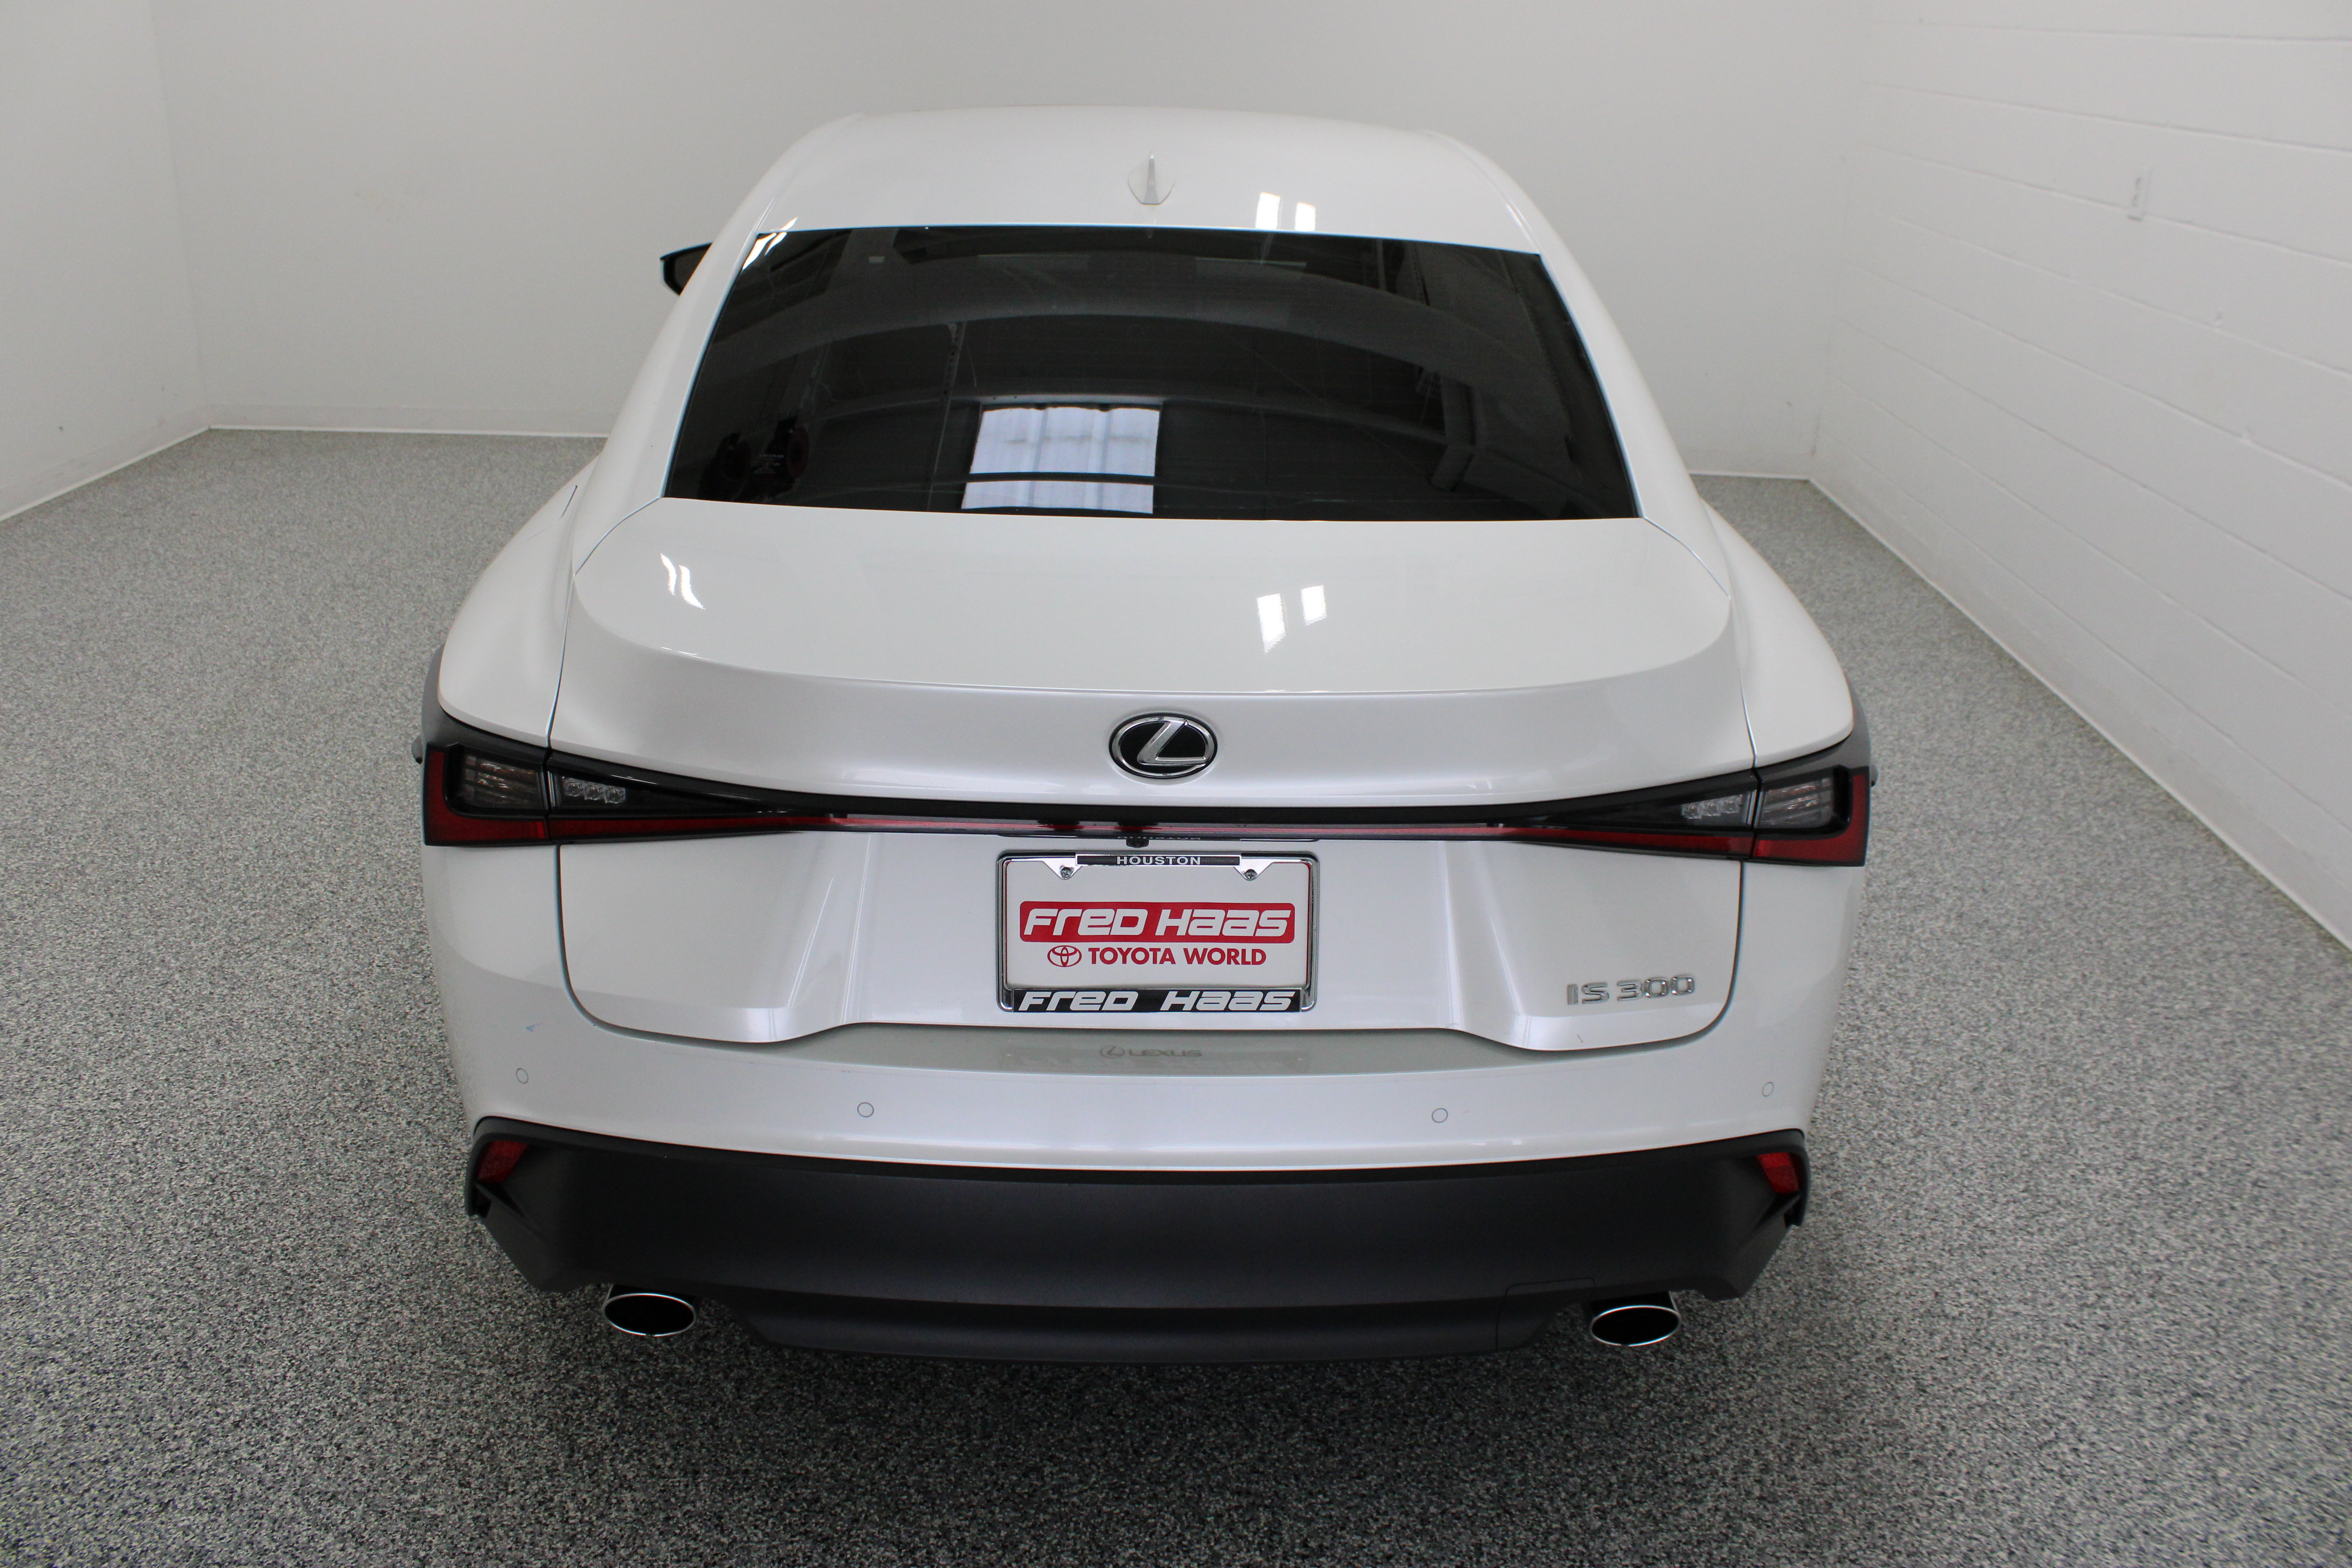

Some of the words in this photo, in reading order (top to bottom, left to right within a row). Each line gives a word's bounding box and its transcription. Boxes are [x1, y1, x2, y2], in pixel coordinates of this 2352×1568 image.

[1117, 856, 1201, 865] HOUSTON
[1089, 947, 1176, 965] TOYOTA
[1183, 948, 1267, 965] WORLD
[1567, 982, 1610, 1005] IS
[1617, 974, 1695, 1001] 300
